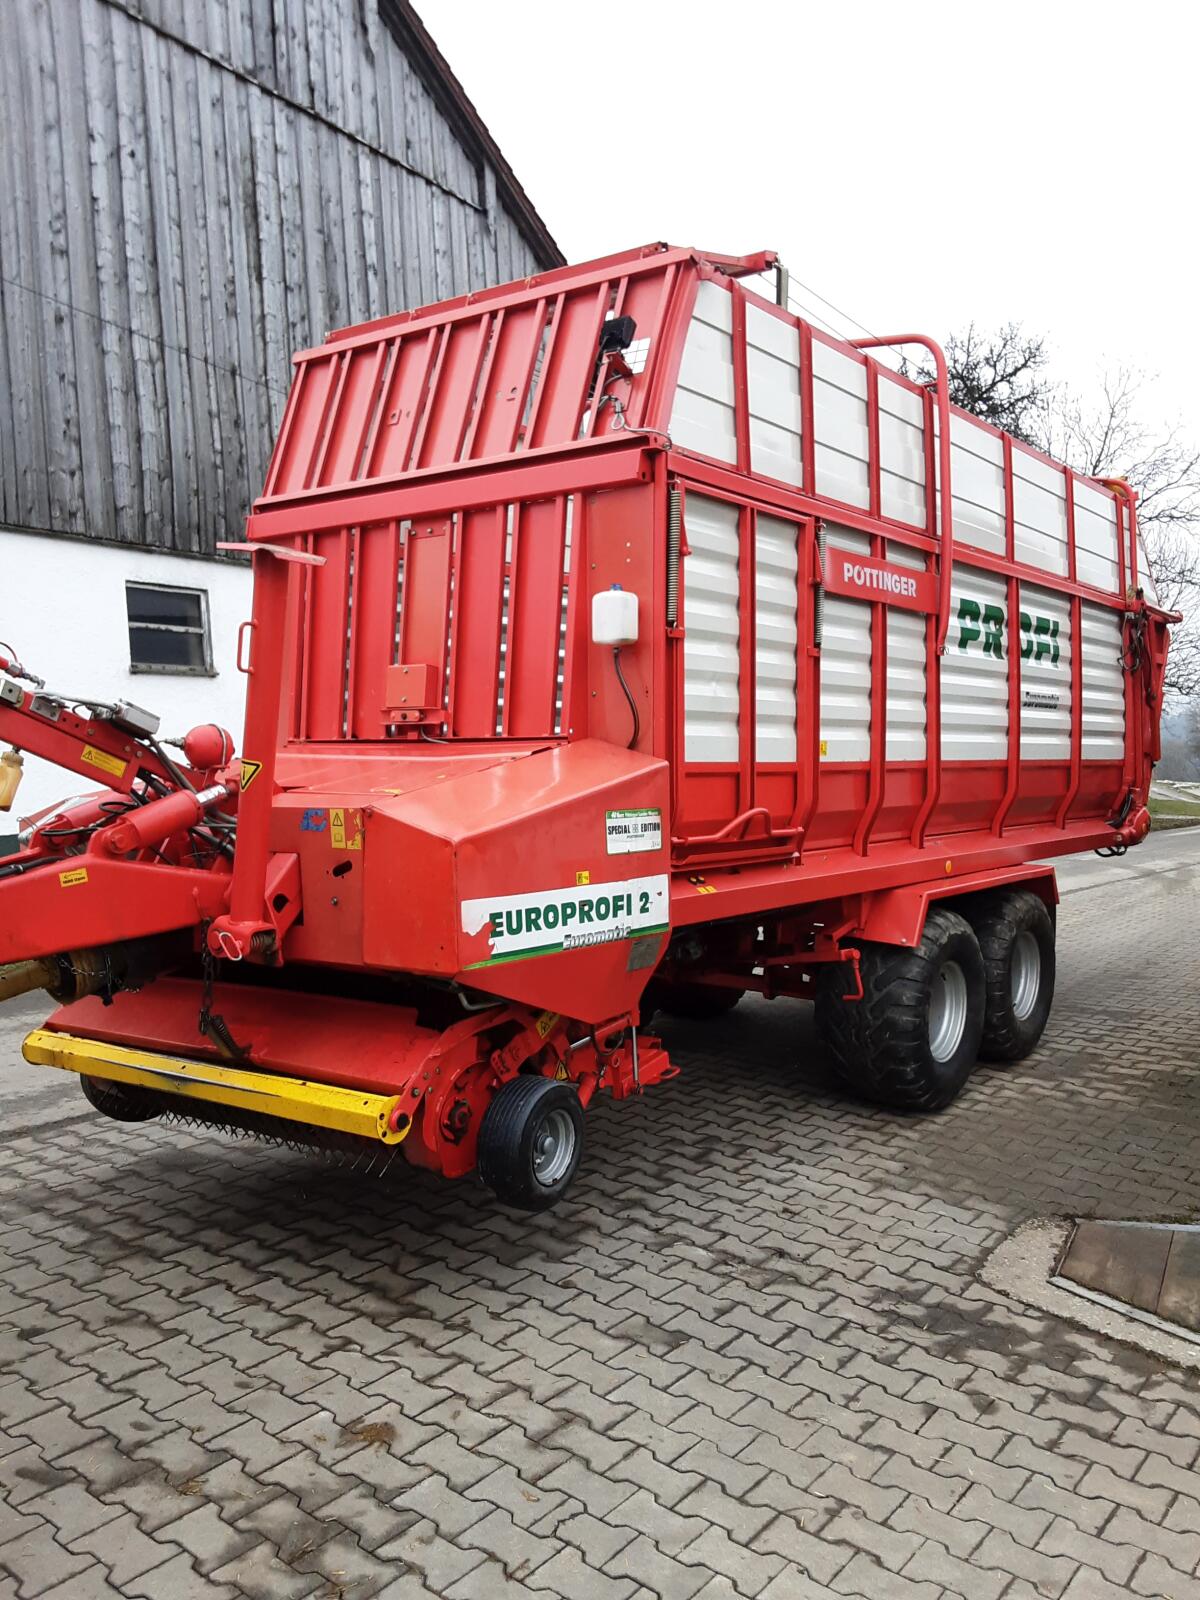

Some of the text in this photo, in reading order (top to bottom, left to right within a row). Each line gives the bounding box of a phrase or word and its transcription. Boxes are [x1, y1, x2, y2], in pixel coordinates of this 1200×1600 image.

[607, 824, 631, 836] SPECIAL
[640, 822, 660, 833] EDITION
[489, 891, 651, 939] EUROPROFI 2
[562, 924, 632, 951] Euromatic
